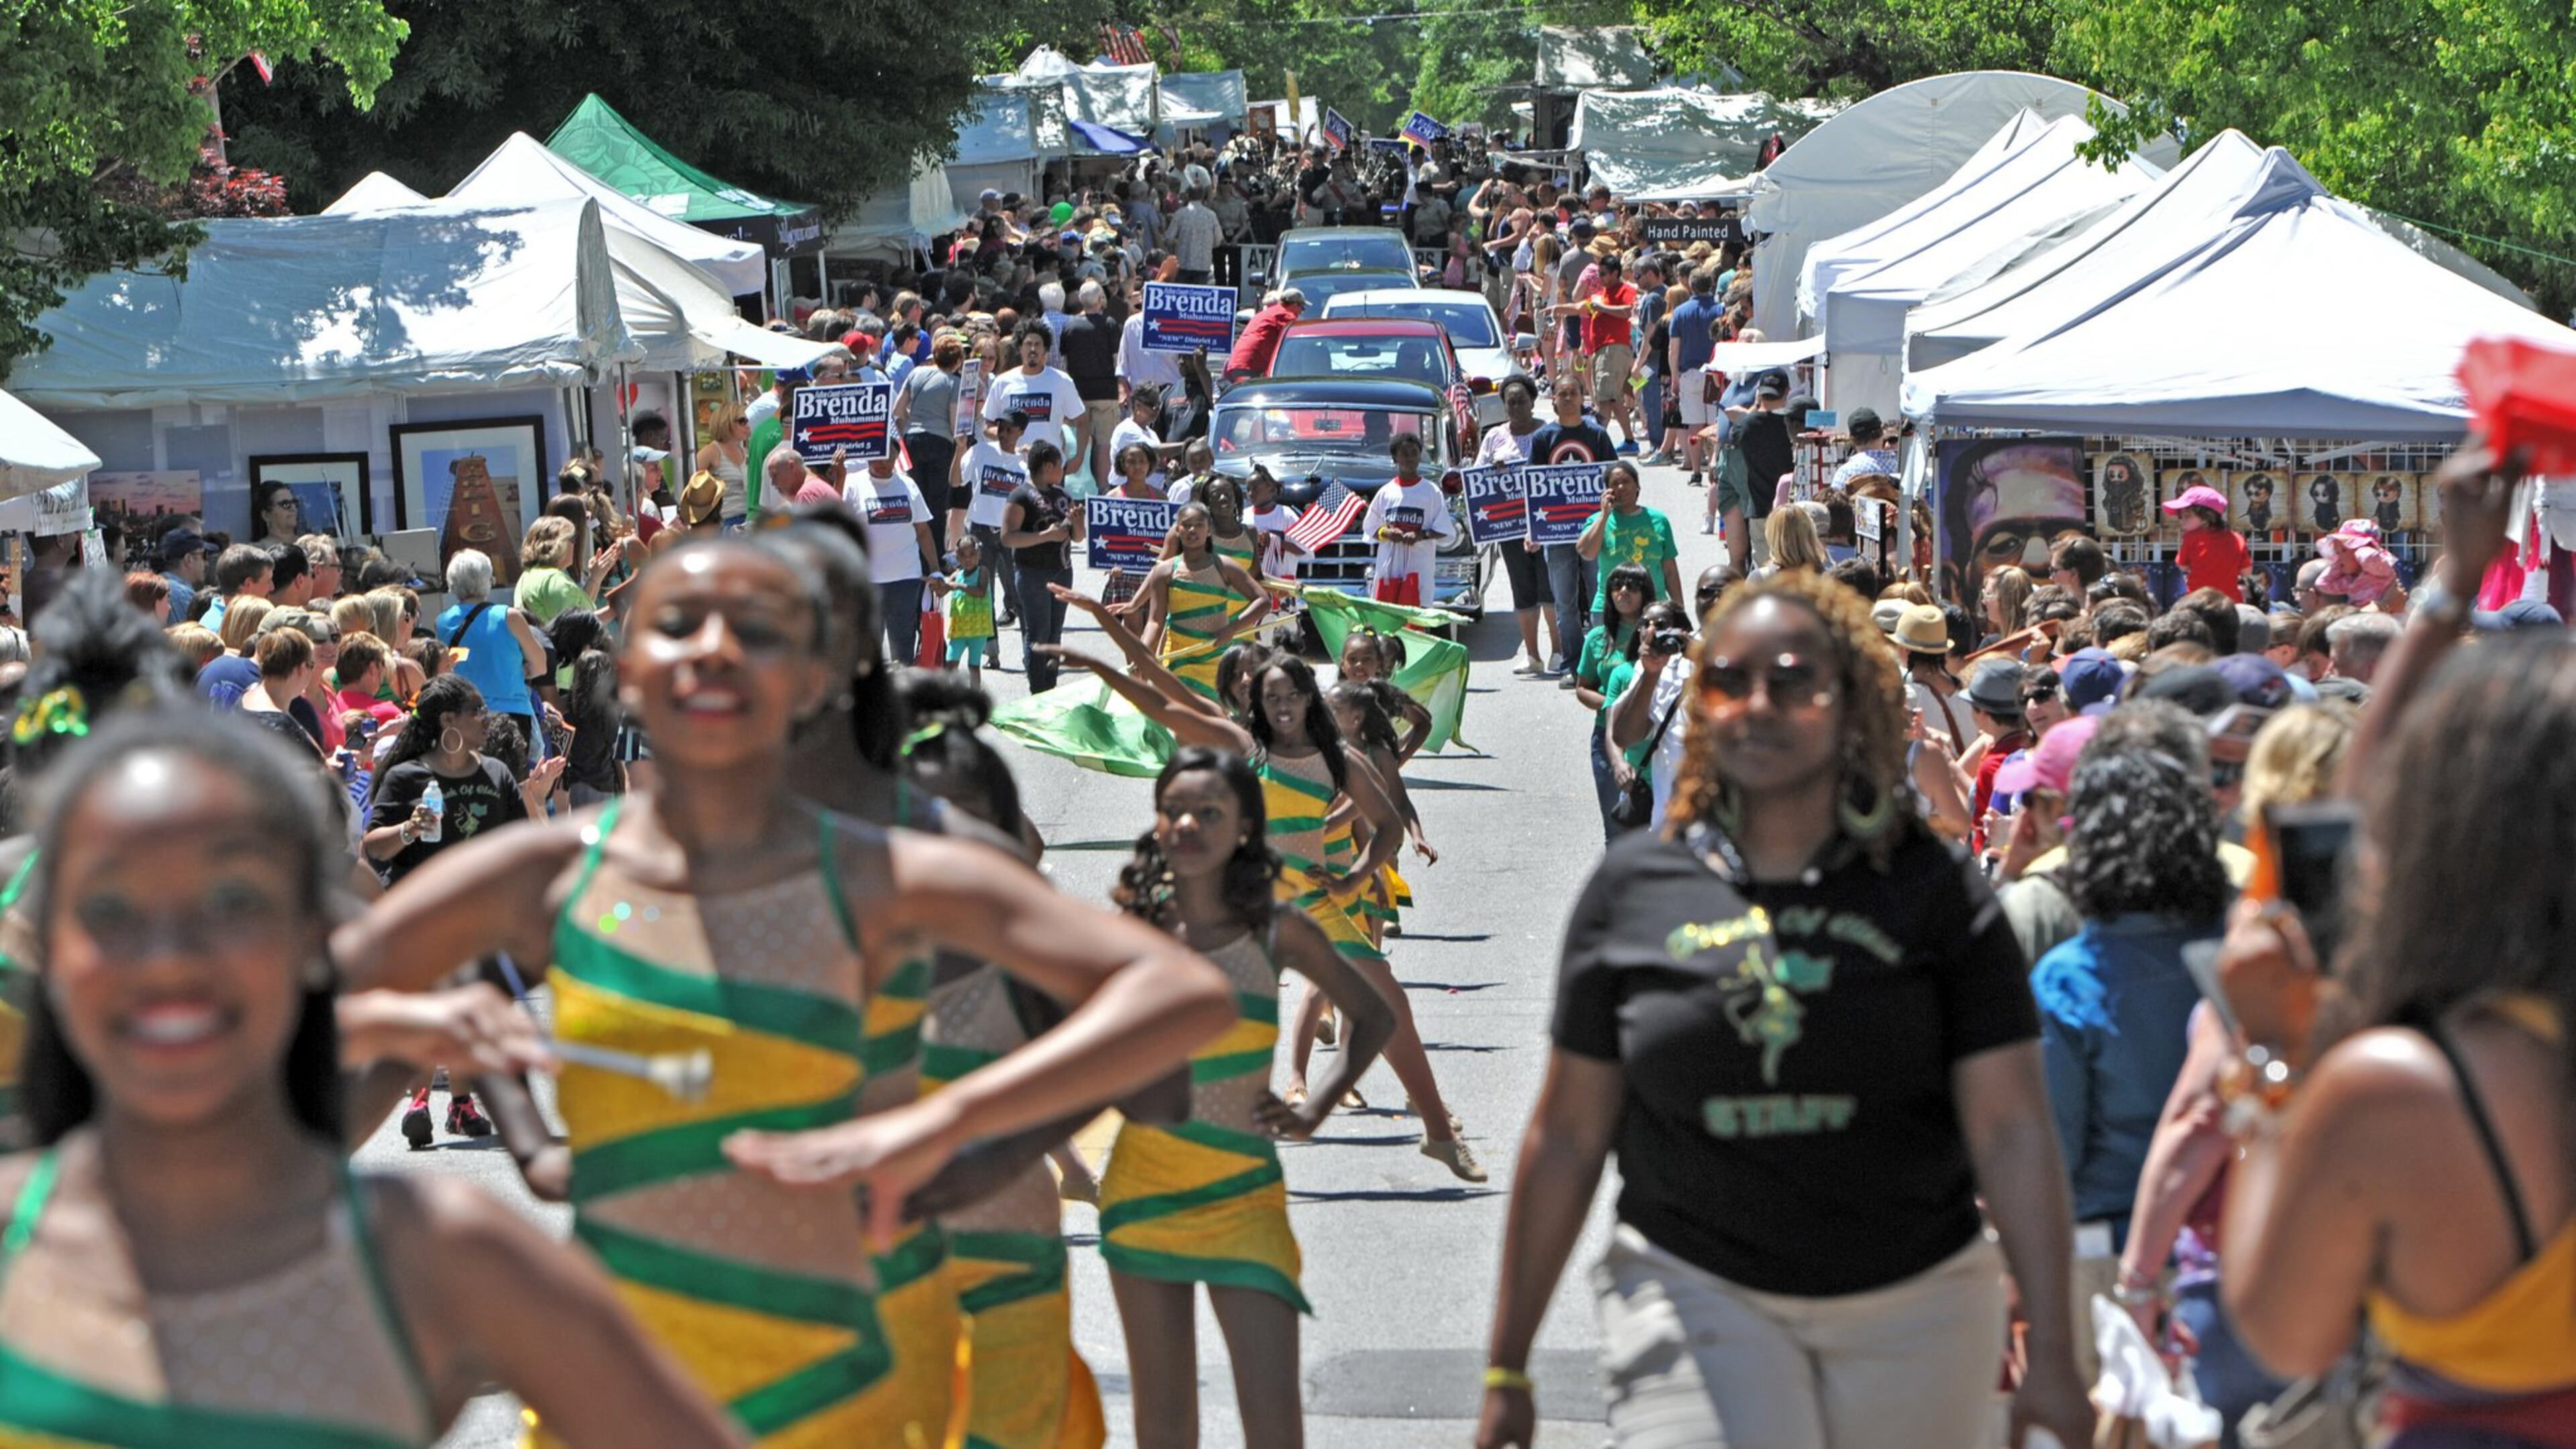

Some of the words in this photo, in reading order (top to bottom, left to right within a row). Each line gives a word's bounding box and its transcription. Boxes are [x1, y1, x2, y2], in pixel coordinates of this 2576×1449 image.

[1648, 224, 1678, 238] Hand
[1682, 224, 1728, 238] Painted
[1147, 287, 1232, 315] Brenda
[1179, 313, 1230, 322] Muhammad
[1185, 335, 1210, 344] District
[796, 387, 888, 419] Brenda
[830, 413, 885, 424] Muhammad
[837, 441, 865, 449] District
[1466, 472, 1523, 498] Bren
[1527, 466, 1608, 497] Brend
[1565, 494, 1601, 504] Muham
[1090, 500, 1176, 529] Brend
[1128, 528, 1166, 537] Muham
